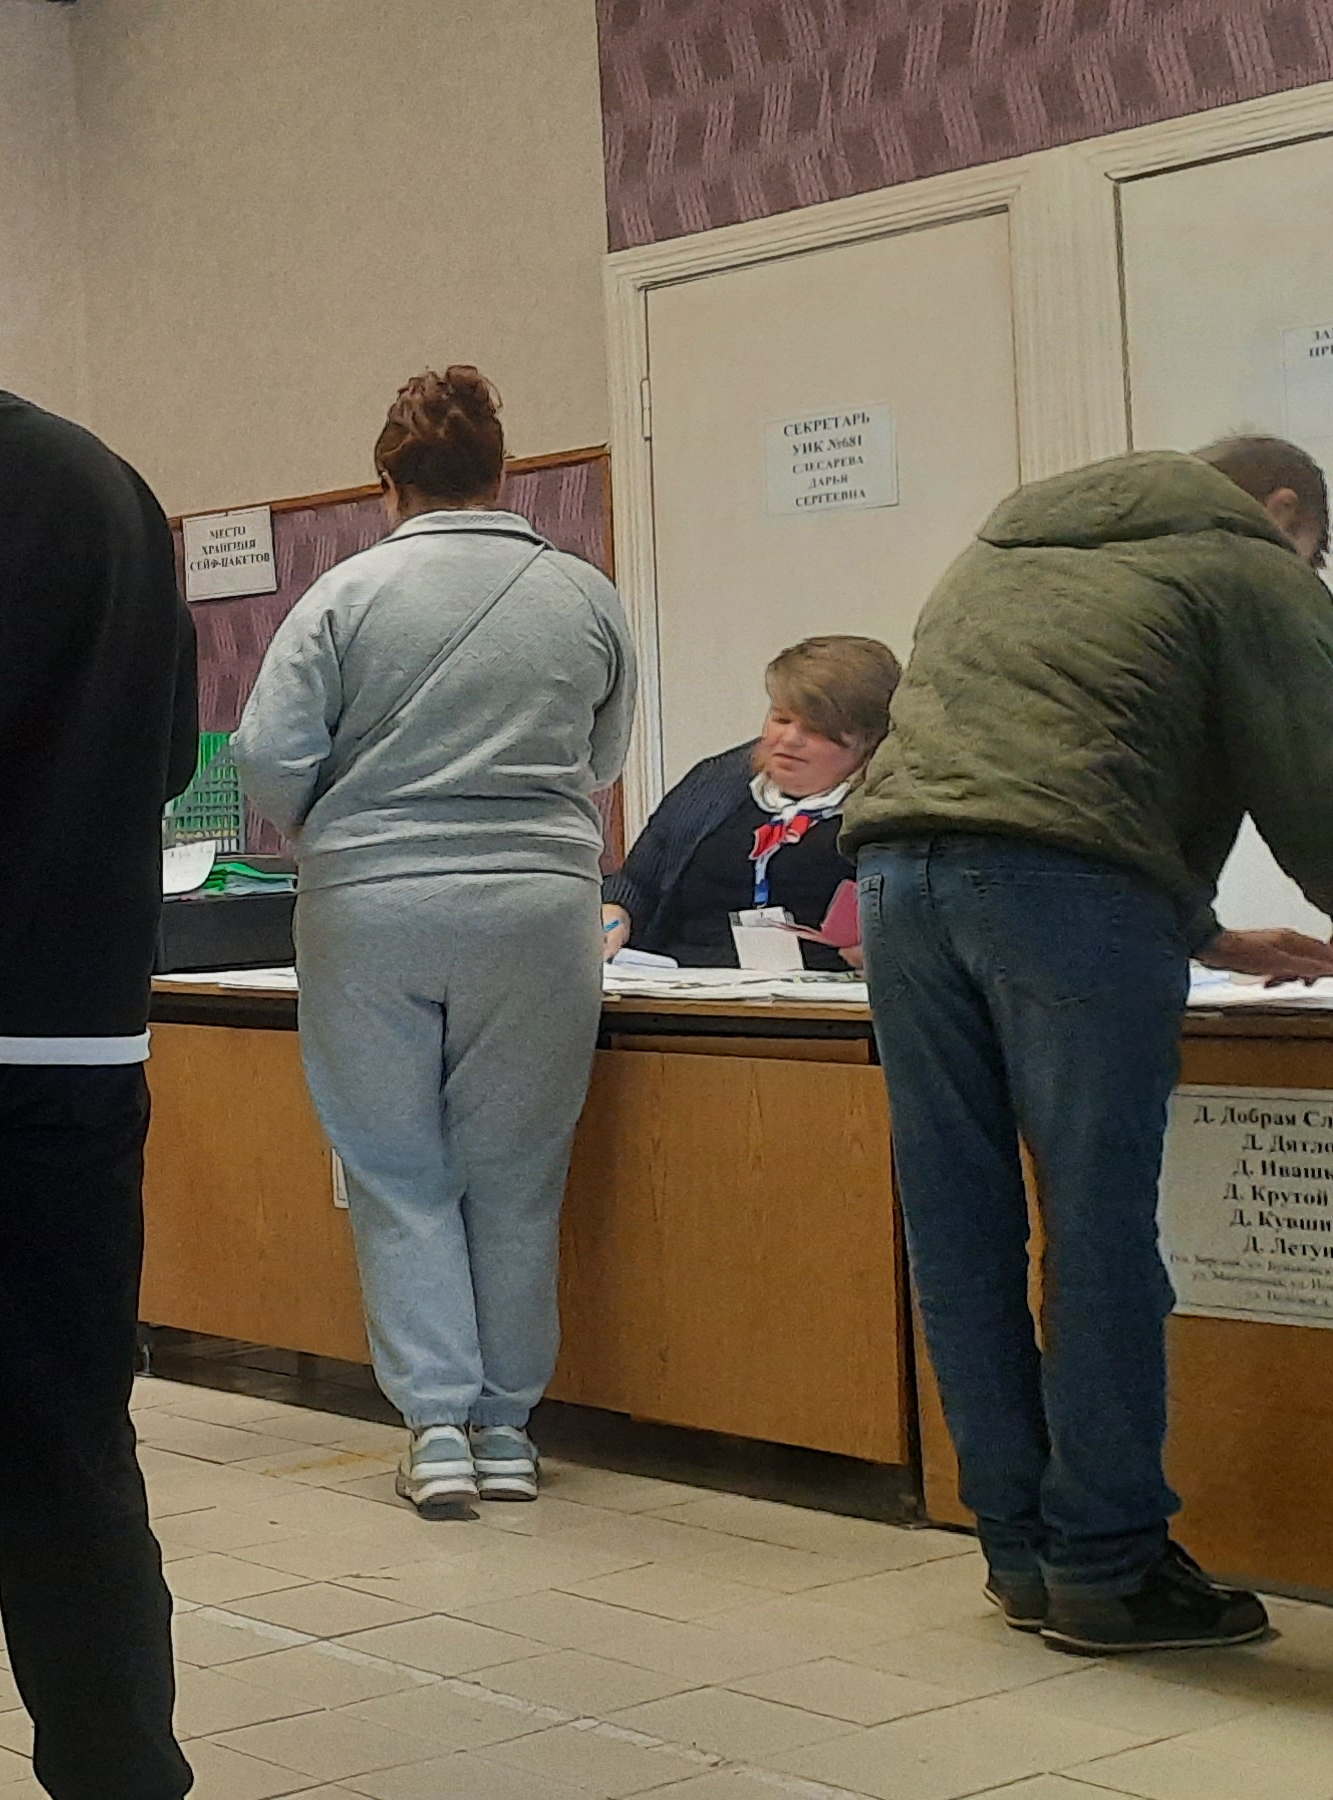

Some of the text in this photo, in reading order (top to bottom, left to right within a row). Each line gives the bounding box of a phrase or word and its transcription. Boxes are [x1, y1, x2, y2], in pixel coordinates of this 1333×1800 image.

[783, 412, 870, 437] СЕКРЕТАРЬ
[792, 440, 824, 456] УИК
[792, 455, 864, 474] СЛЕСАРЕВА
[808, 474, 848, 489] ДАРЬЯ
[795, 489, 866, 507] СЕРГЕЕВНА
[209, 525, 246, 539] МЕСТО
[201, 539, 257, 555] ХРАНЕНИЯ
[189, 552, 270, 571] СЕЙФ-ПАКЕТОВ
[1220, 1106, 1296, 1129] Добрая
[1233, 1159, 1254, 1177] Д.
[1251, 1185, 1328, 1207] Крутой
[1230, 1208, 1252, 1227] Д.
[1244, 1235, 1264, 1254] Д.
